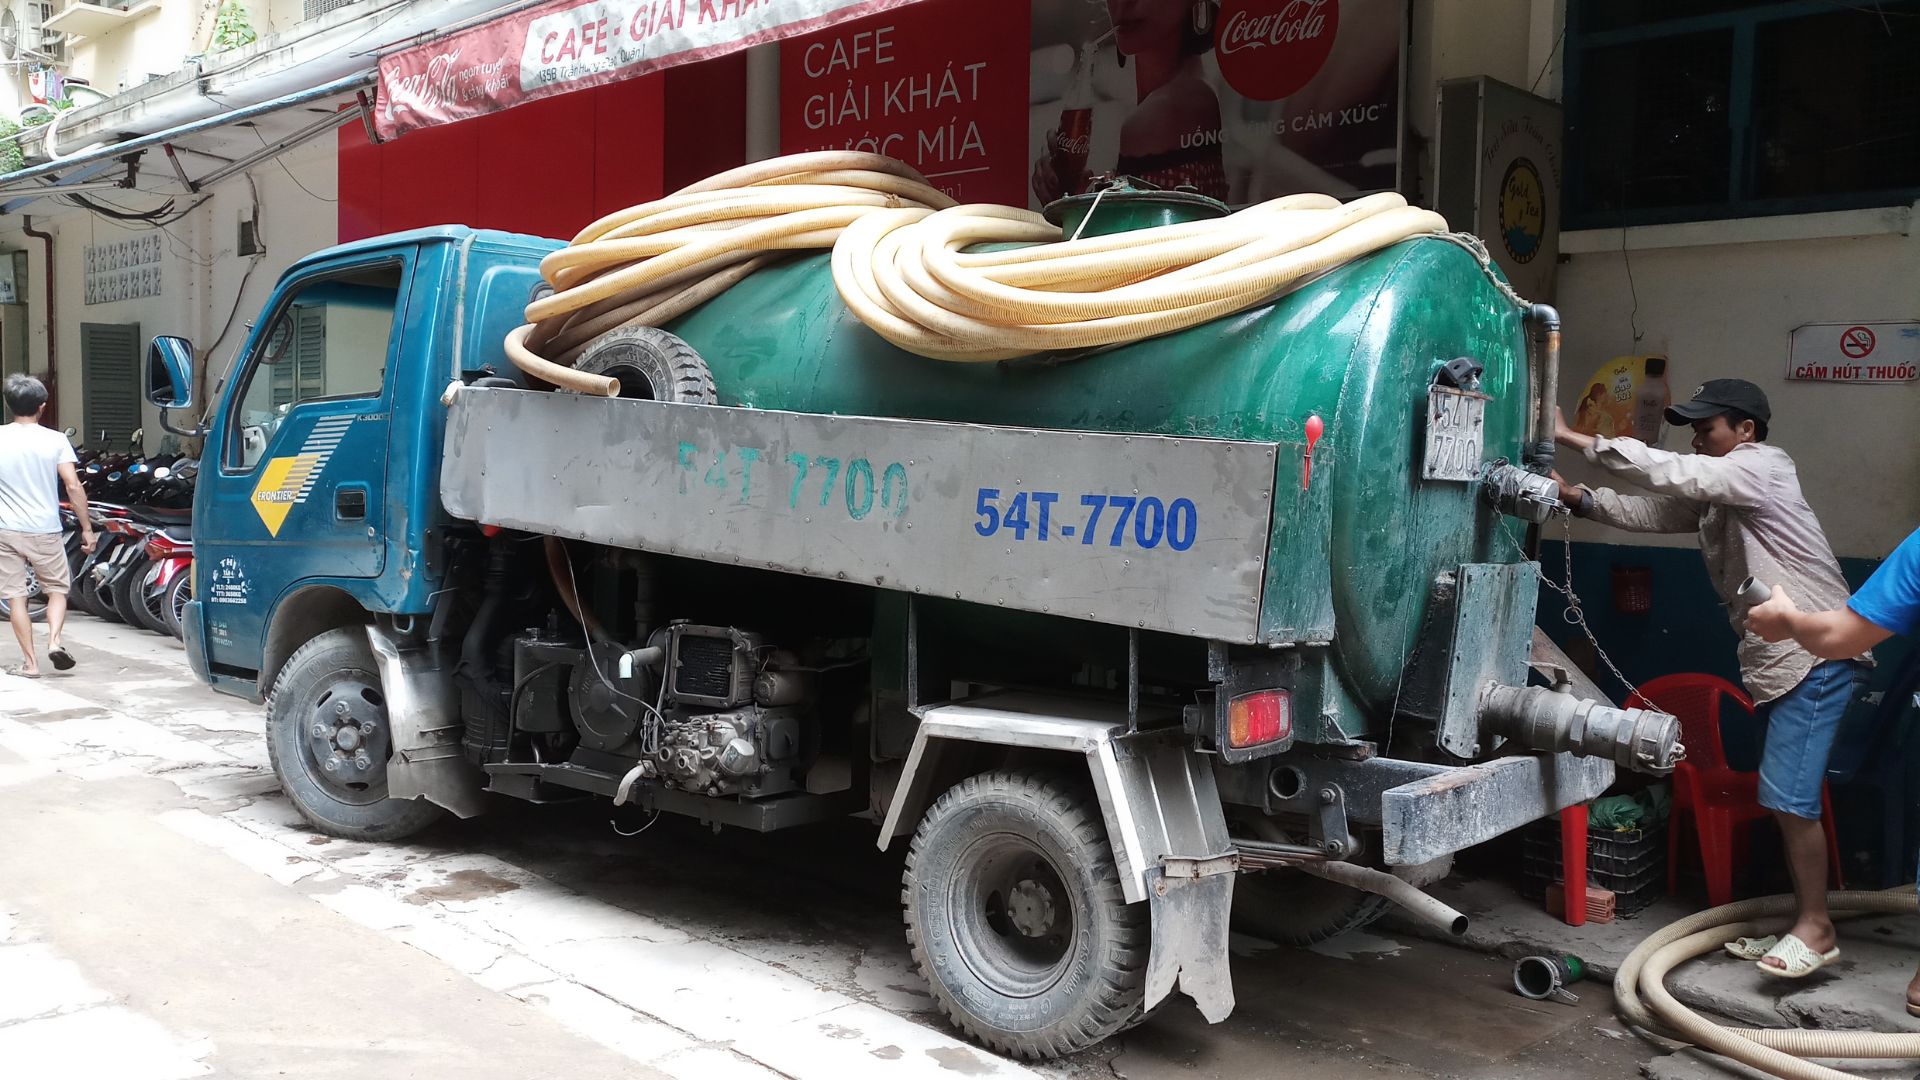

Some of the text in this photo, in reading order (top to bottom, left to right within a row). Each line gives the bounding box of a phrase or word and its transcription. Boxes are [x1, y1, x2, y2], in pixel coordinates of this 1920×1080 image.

[1221, 0, 1326, 54] Coca-Cola
[804, 26, 895, 78] CAFE
[804, 61, 987, 130] GIẢI KHÁT
[917, 116, 987, 165] MÍA
[1291, 109, 1333, 132] CẢM
[1796, 361, 1916, 379] CẤM HÚT THUỐC
[1433, 435, 1476, 476] 7700
[257, 491, 293, 501] FRONTIER
[974, 488, 1198, 551] 54T-7700
